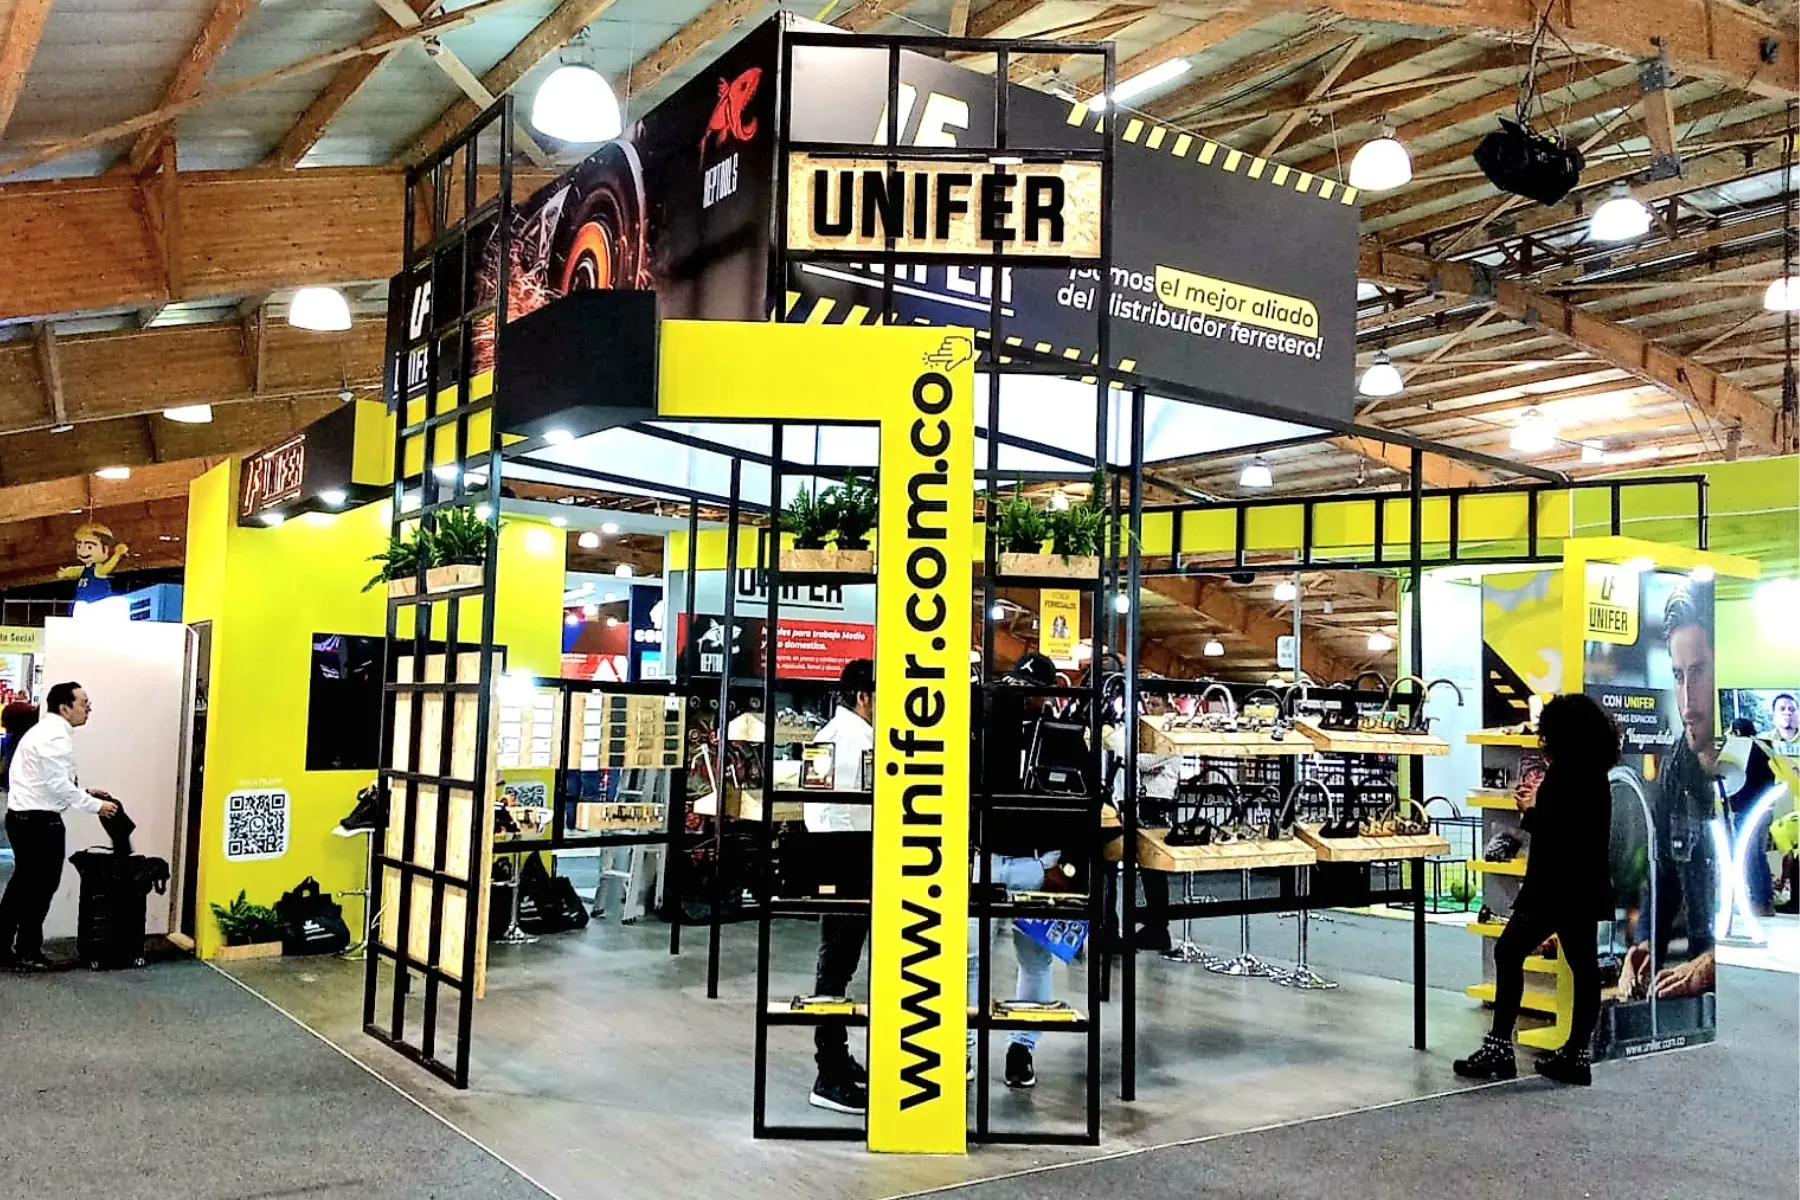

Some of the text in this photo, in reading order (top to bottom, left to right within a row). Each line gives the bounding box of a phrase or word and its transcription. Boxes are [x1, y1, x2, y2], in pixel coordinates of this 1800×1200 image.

[813, 168, 1066, 244] UNIFER
[1057, 283, 1095, 311] del
[1230, 321, 1325, 361] ferretero!
[1160, 278, 1180, 297] el
[1186, 287, 1247, 312] mejor
[1252, 300, 1315, 328] aliado
[791, 629, 811, 640] para
[812, 630, 841, 641] trabajo
[841, 631, 866, 641] Medio
[1588, 606, 1628, 632] UNIFER
[1602, 694, 1656, 710] CON UNIFER
[886, 372, 952, 1111] www.unifer.com.co
